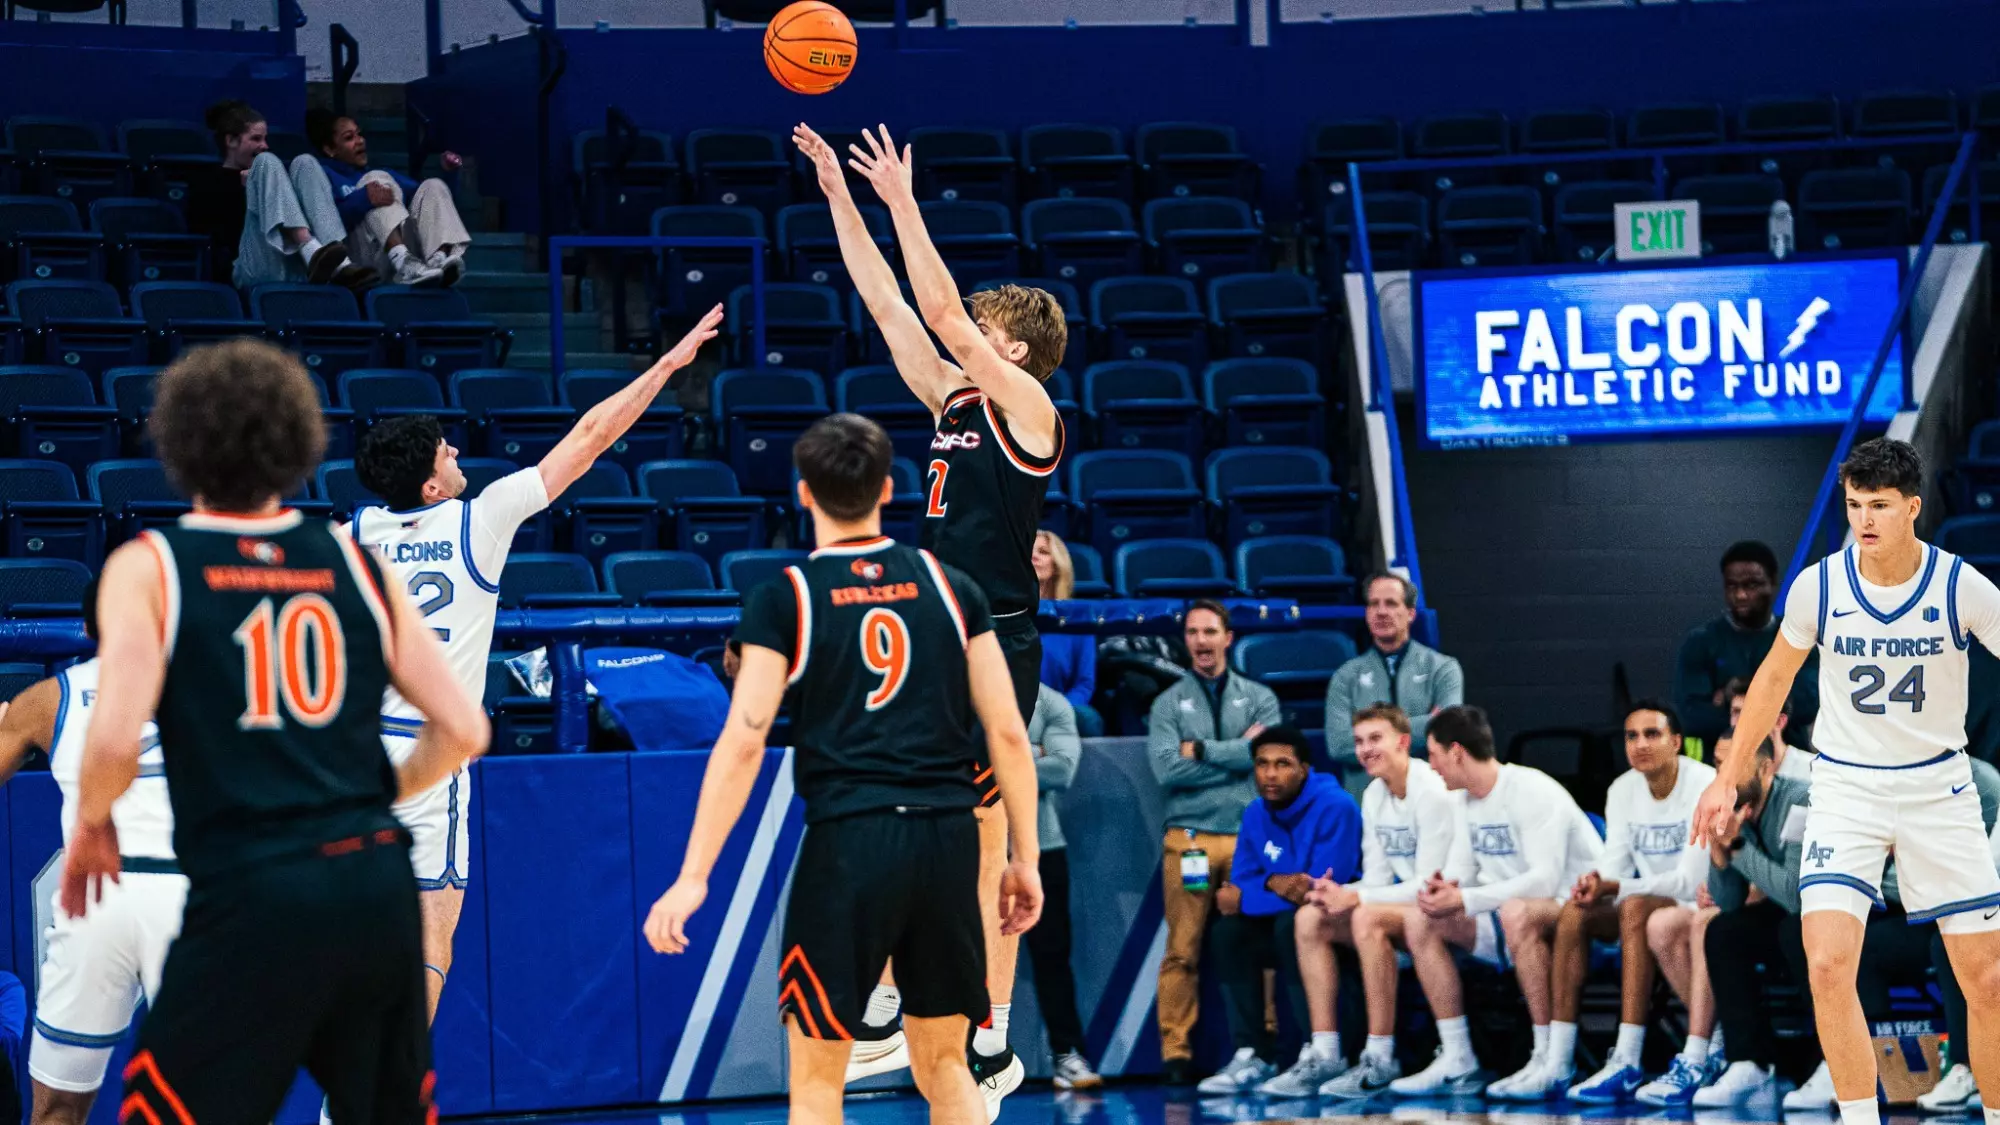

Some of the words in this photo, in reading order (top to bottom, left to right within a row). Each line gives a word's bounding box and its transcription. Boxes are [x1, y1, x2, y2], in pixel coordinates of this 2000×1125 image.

[809, 50, 852, 68] ELITE
[1630, 209, 1687, 252] EXIT
[1475, 298, 1765, 373] FALCON
[1478, 366, 1695, 409] ATHLETIC
[1723, 360, 1842, 399] FUND
[926, 459, 949, 517] 2
[231, 593, 348, 732] 10
[860, 607, 911, 712] 9
[1833, 635, 1866, 657] AIR
[1871, 636, 1945, 657] FORCE
[1849, 665, 1925, 714] 24
[1805, 840, 1834, 868] AF
